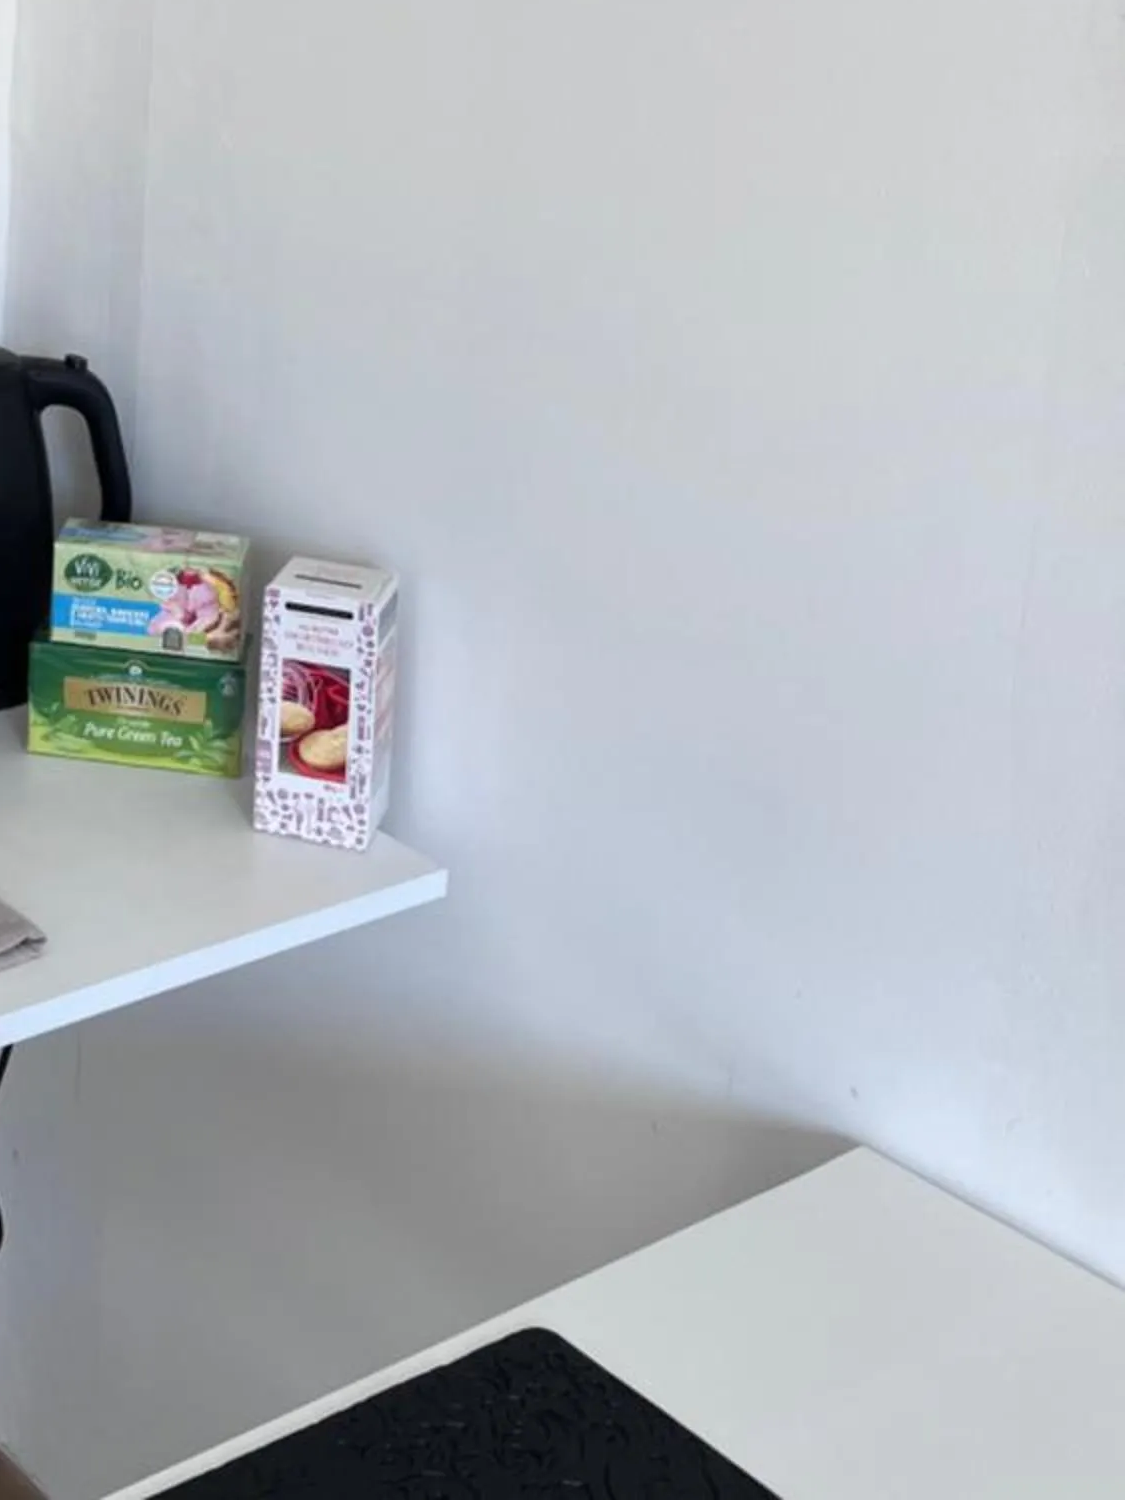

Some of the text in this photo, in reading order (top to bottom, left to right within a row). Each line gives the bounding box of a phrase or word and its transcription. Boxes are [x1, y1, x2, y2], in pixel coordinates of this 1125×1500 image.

[86, 685, 186, 716] TWININGS
[83, 721, 115, 740] Pure
[117, 725, 157, 744] Green
[160, 730, 183, 748] Tea
